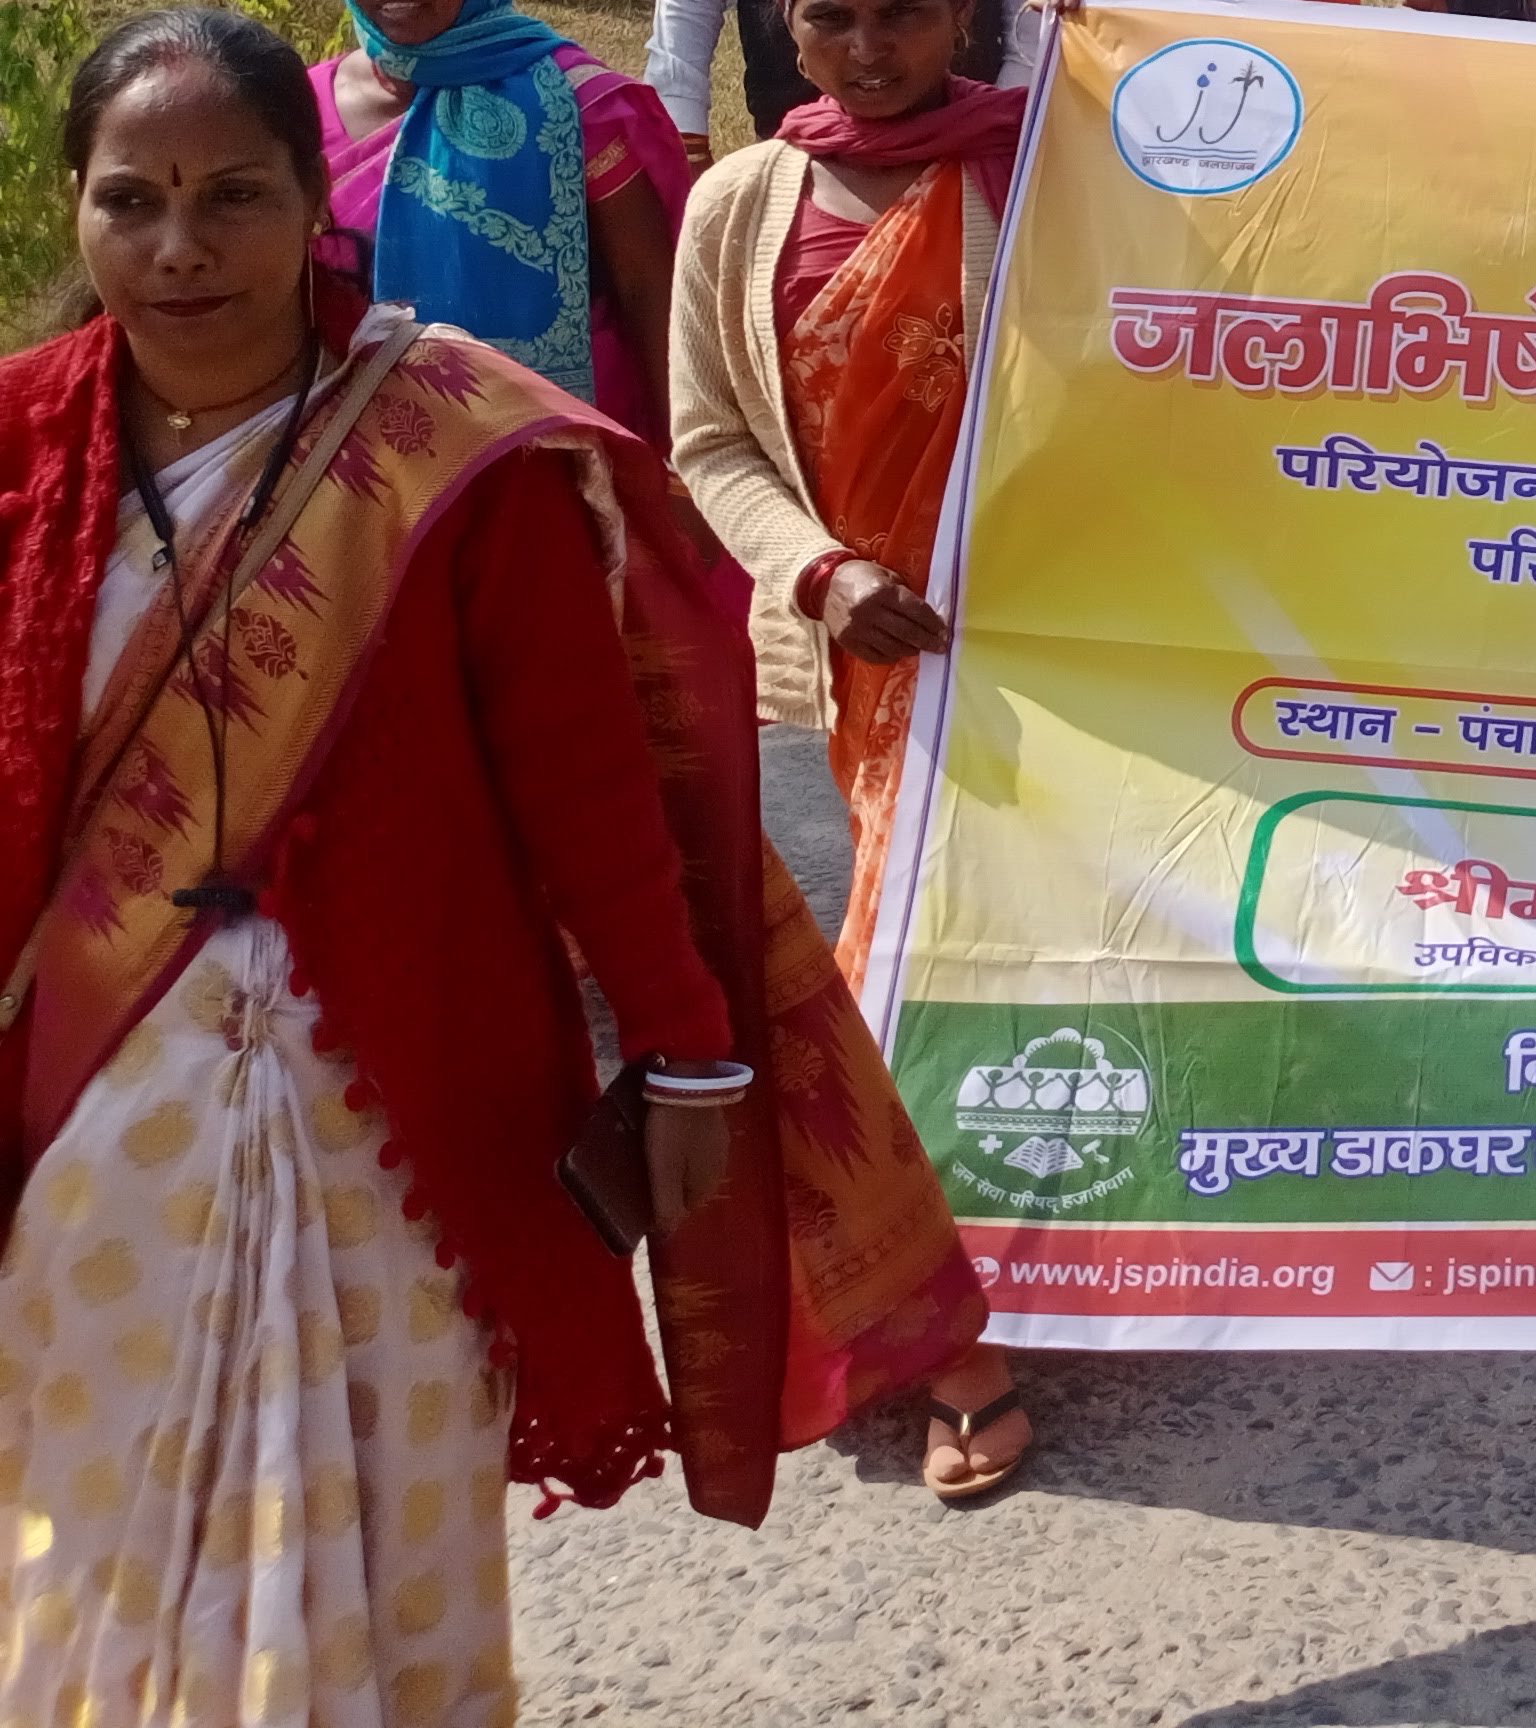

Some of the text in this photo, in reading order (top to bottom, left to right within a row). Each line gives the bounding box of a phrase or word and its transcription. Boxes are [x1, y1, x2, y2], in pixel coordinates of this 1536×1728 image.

[1276, 699, 1396, 745] स्थान
[1179, 1125, 1327, 1196] मुख्य
[1330, 1125, 1526, 1177] डाकघर
[1010, 1256, 1335, 1296] www.jspindia.org
